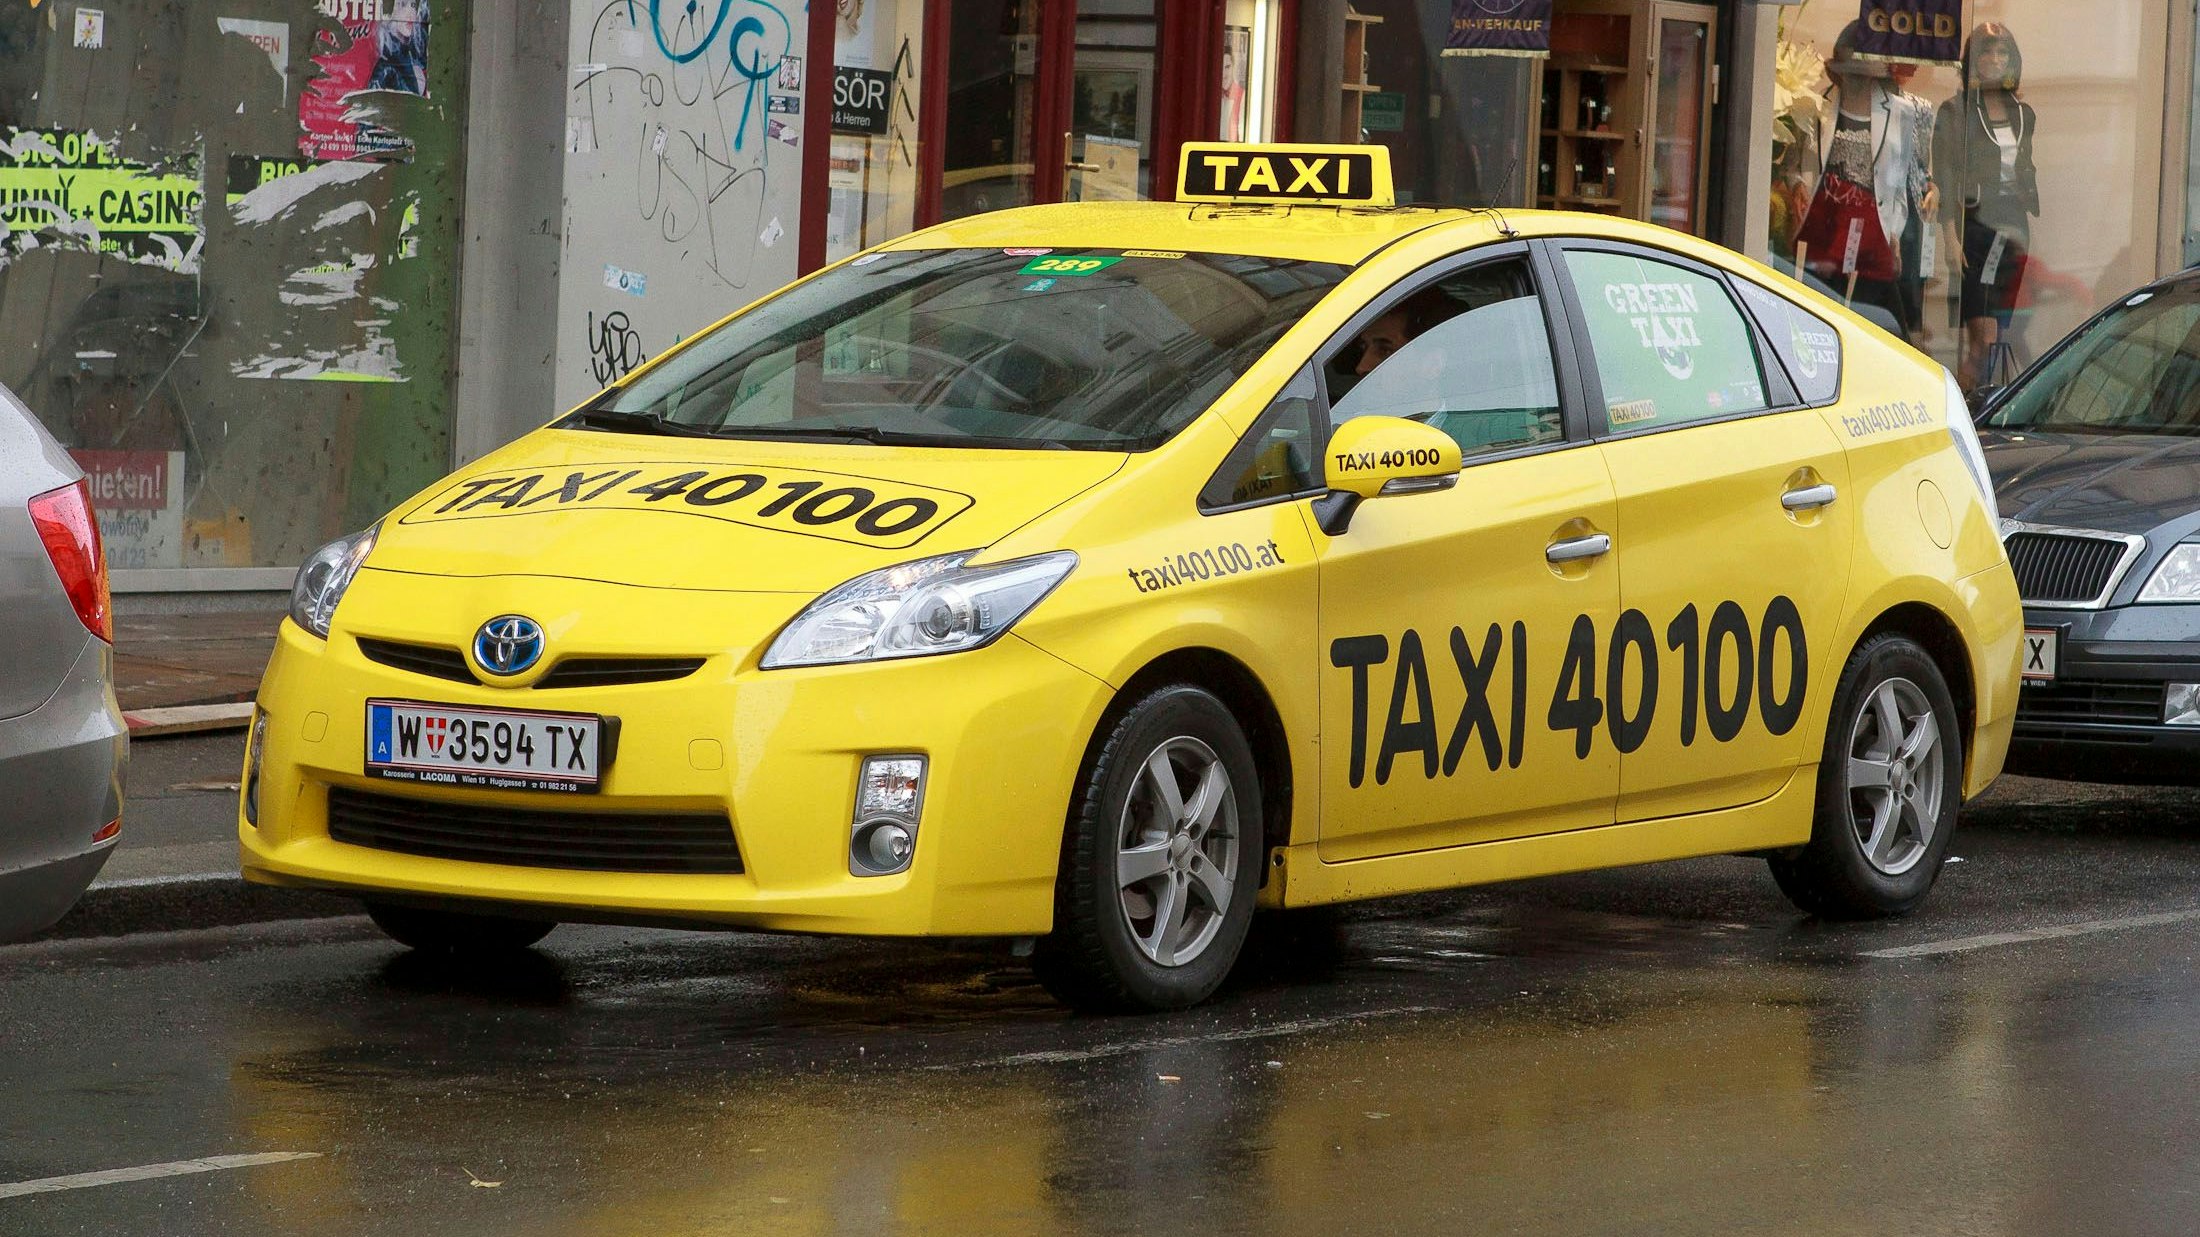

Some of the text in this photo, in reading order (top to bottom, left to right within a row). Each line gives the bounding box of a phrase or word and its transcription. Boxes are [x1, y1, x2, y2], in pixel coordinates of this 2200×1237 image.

[1454, 18, 1542, 31] AN-VERKAUF
[1868, 9, 1957, 38] GOLD
[843, 112, 871, 126] Herren
[63, 132, 134, 165] OPE
[1203, 156, 1351, 194] TAXI
[1032, 259, 1102, 272] 289
[1605, 283, 1699, 313] GREEN
[1631, 316, 1703, 348] TAXI
[1842, 401, 1934, 438] taxi40100.at
[1336, 452, 1375, 472] TAXI
[433, 470, 639, 514] TAXI
[1129, 539, 1285, 593] taxi40100.at
[2024, 638, 2045, 670] X
[1330, 620, 1527, 789] TAXI
[378, 714, 587, 770] A W 3594 TX
[383, 769, 415, 779] Karosserie
[420, 772, 457, 783] LACOMA
[462, 775, 478, 784] Wien
[478, 777, 486, 785] 15
[560, 783, 568, 791] 21
[568, 784, 577, 792] 56
